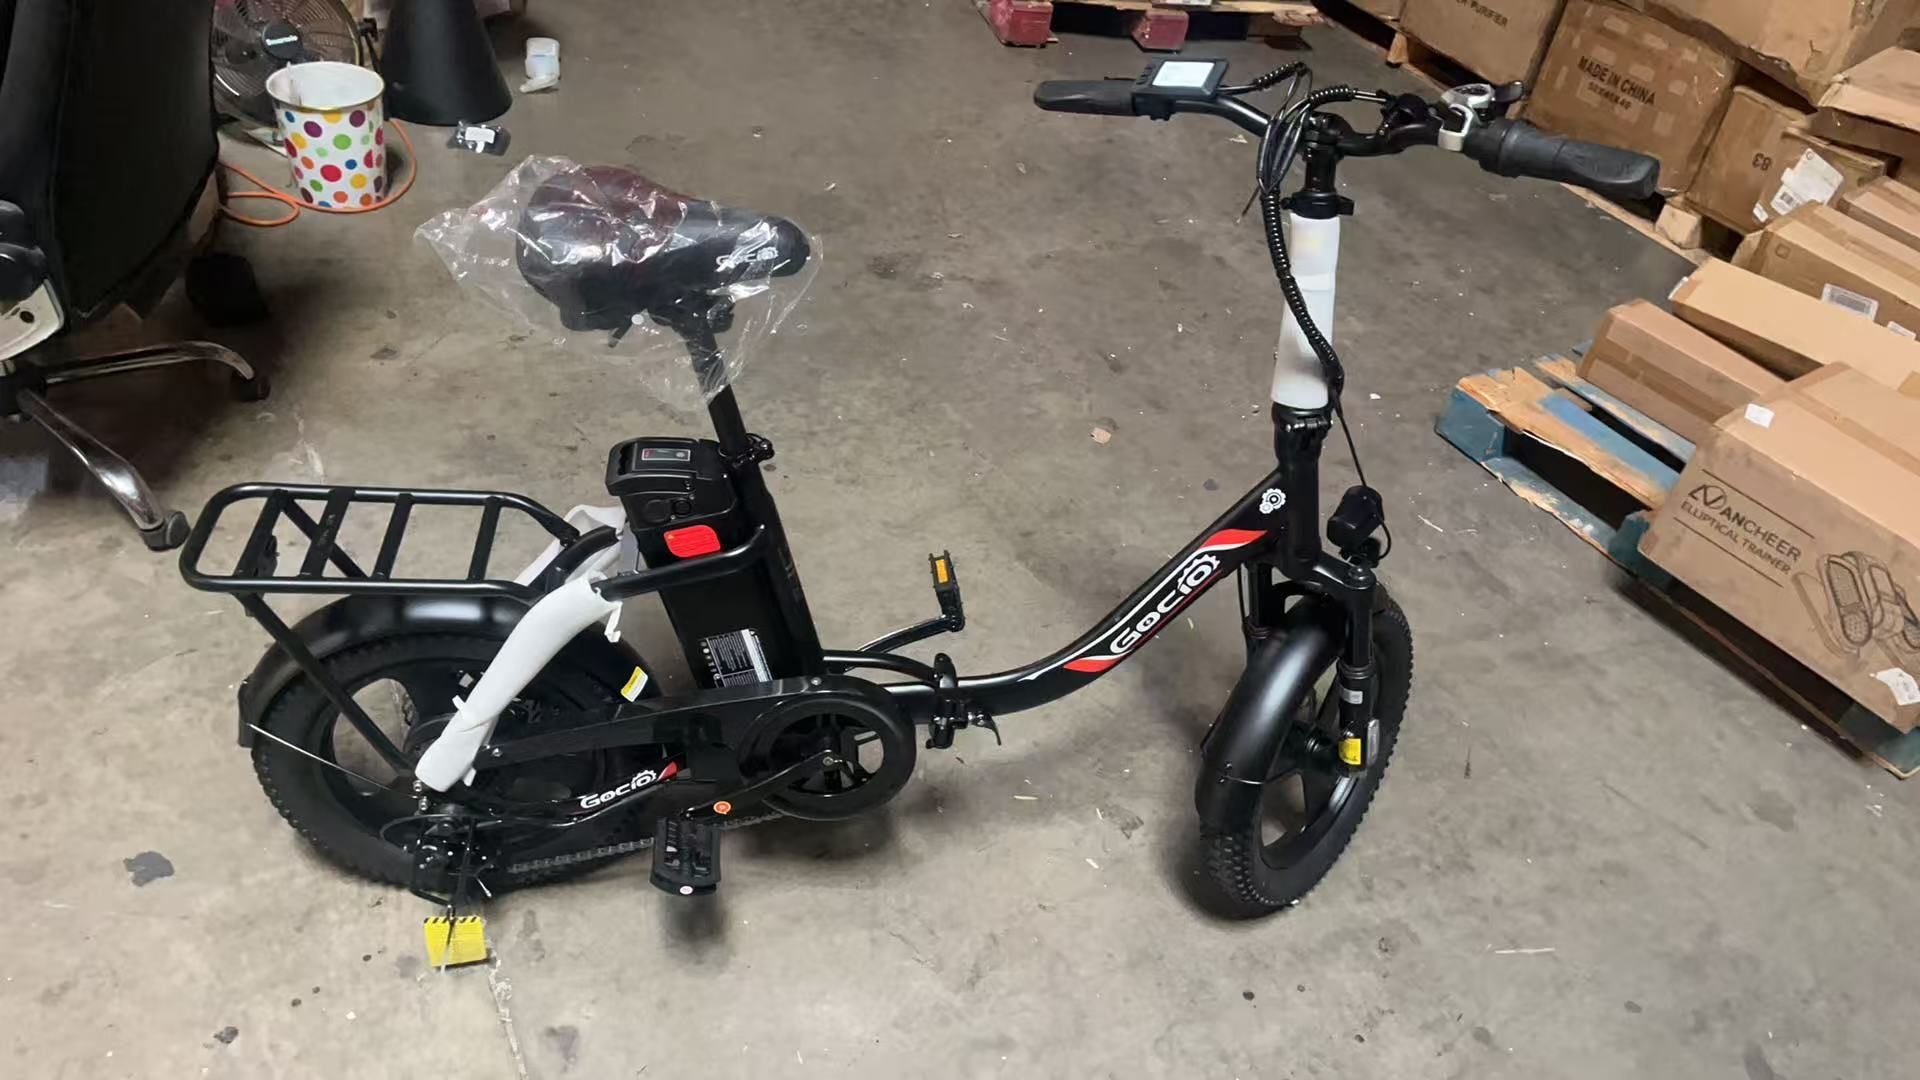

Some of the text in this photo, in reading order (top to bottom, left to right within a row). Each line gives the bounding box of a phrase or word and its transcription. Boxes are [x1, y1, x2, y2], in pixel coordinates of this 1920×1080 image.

[1578, 56, 1608, 82] MADE
[1606, 71, 1622, 88] IN
[1621, 79, 1656, 105] CHINA
[1681, 501, 1792, 575] ELLIPTICAL TRAINER
[1719, 506, 1801, 561] ANCHEER
